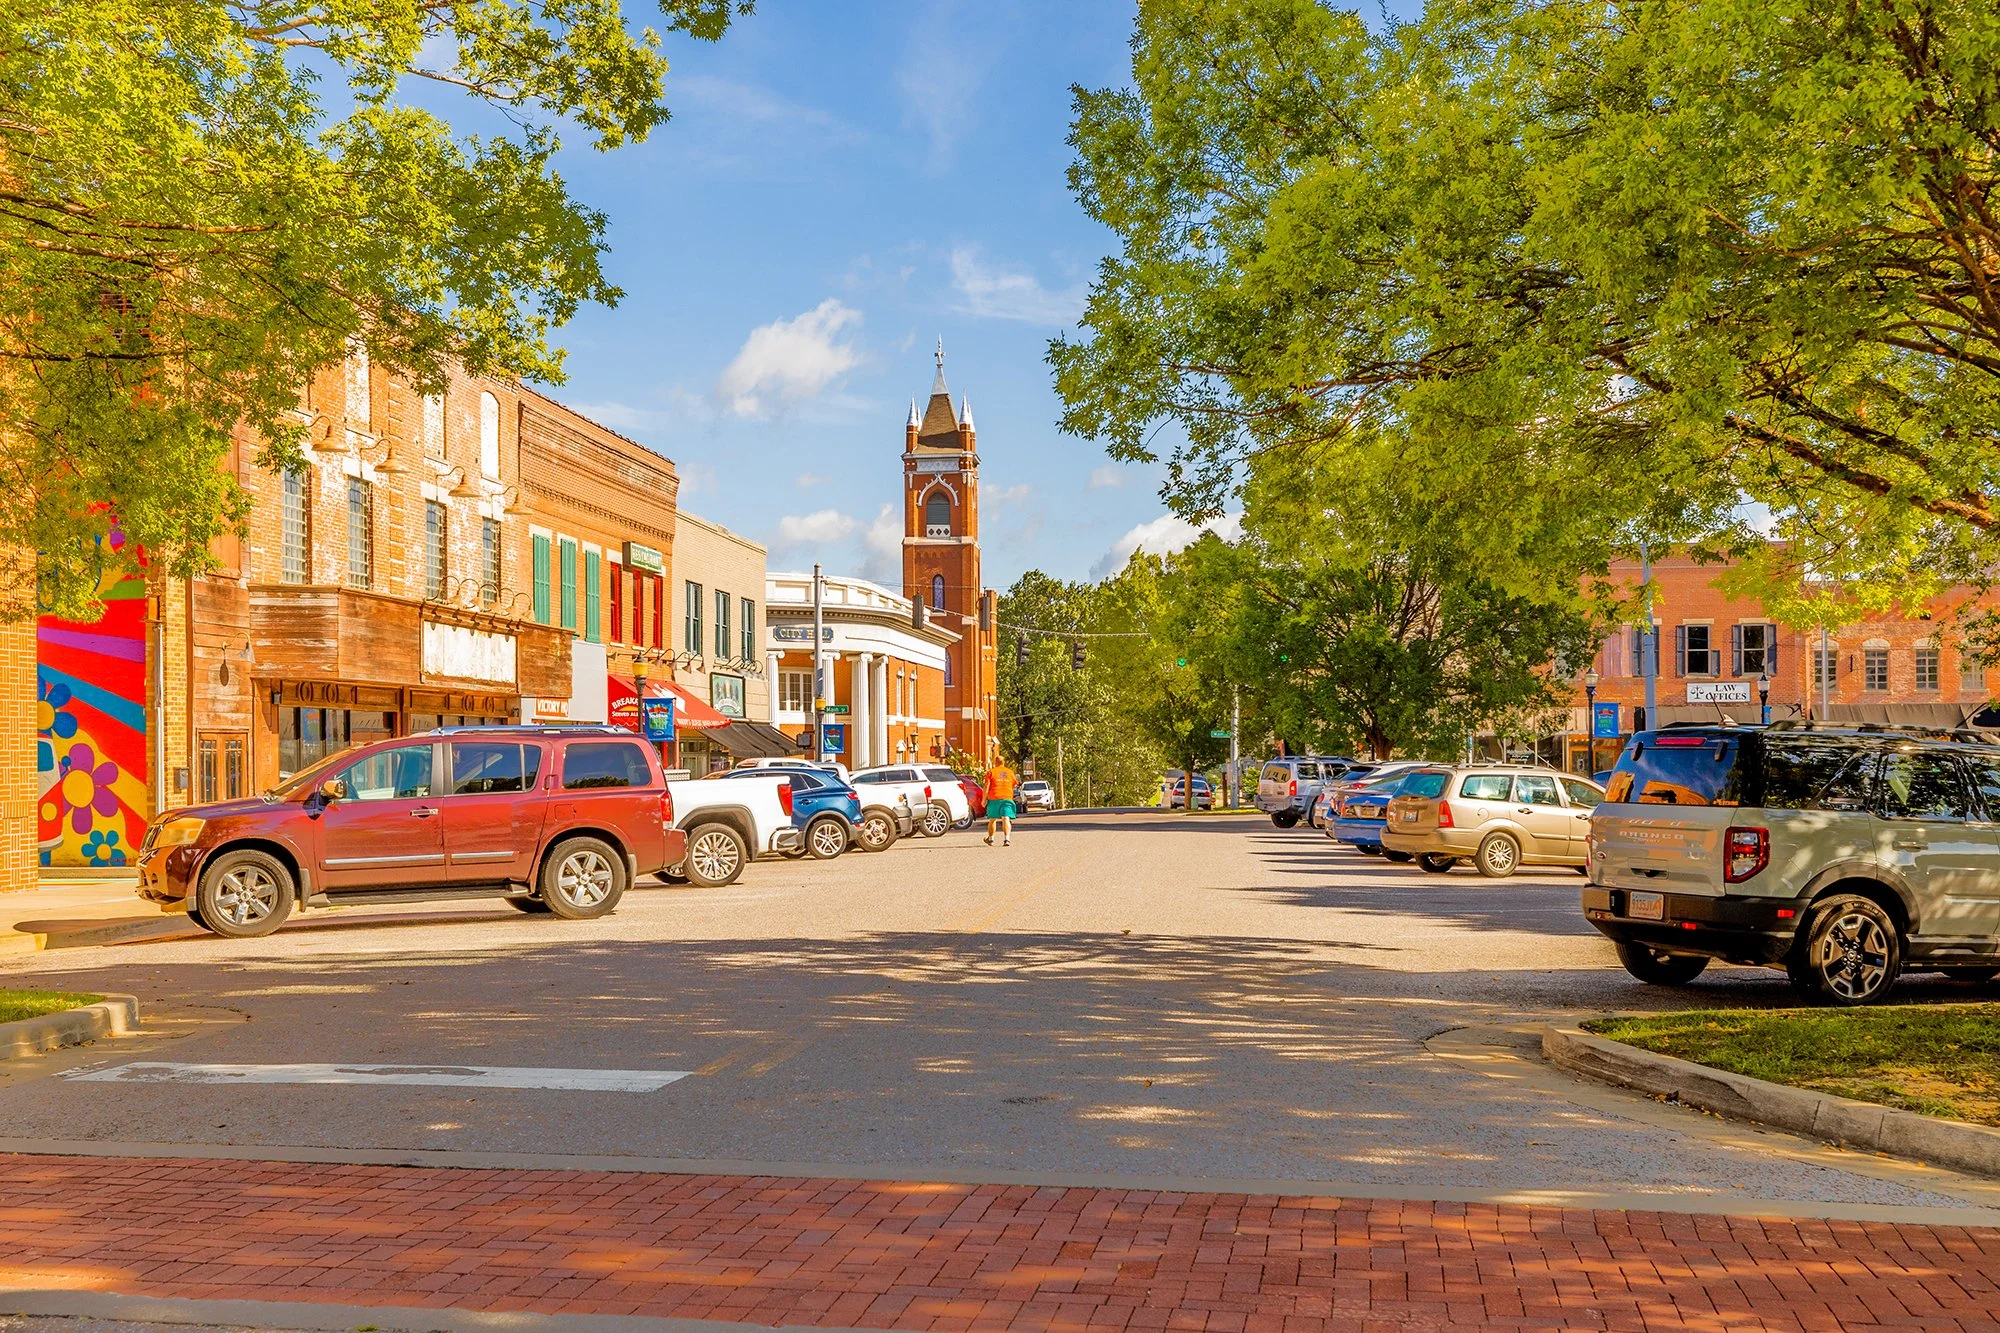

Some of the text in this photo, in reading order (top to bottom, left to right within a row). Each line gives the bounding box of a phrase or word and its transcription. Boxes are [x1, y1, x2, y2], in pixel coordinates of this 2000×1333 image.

[780, 628, 830, 639] CITY HL
[1715, 684, 1737, 692] LAW
[1705, 692, 1747, 700] OFFICES
[537, 698, 561, 713] VICTORY
